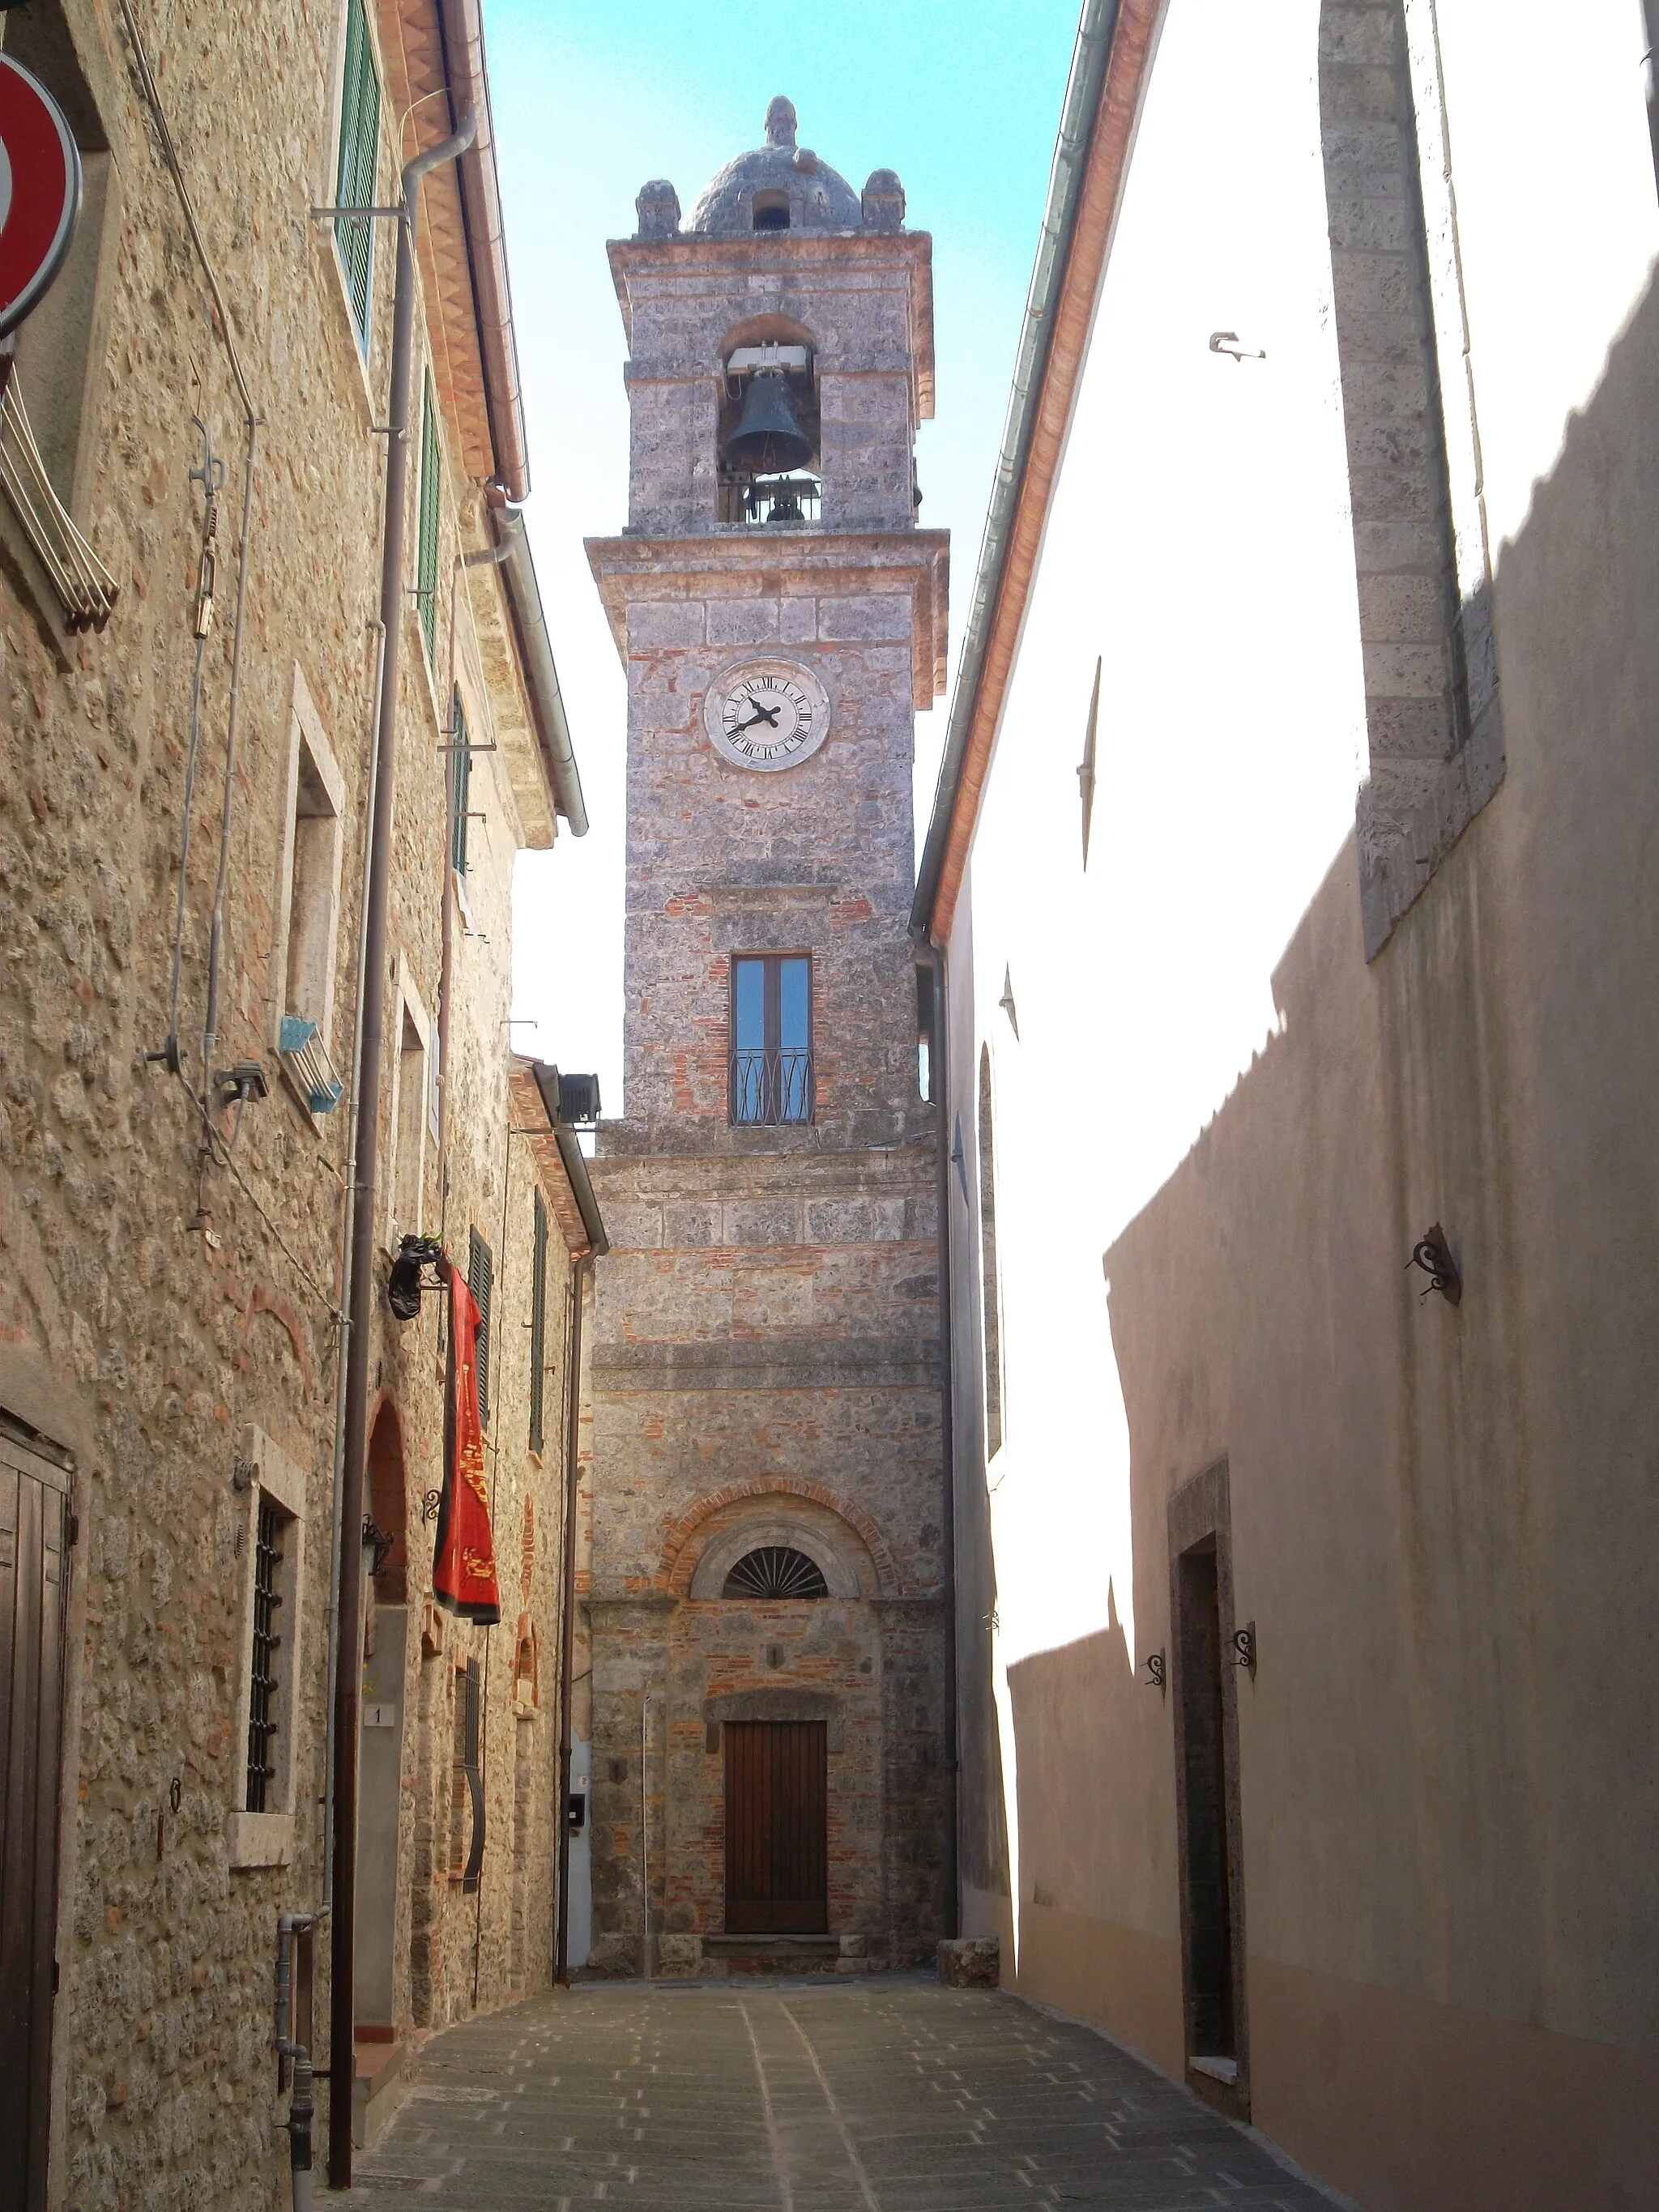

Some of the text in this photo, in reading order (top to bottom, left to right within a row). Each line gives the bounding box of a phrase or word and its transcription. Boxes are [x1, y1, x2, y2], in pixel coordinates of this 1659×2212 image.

[743, 681, 754, 693] XI
[761, 676, 773, 689] XII
[783, 682, 790, 693] I
[794, 695, 807, 704] II
[723, 714, 736, 722] IX
[799, 713, 812, 721] III
[742, 744, 753, 757] VII
[764, 747, 773, 759] VI
[783, 744, 791, 753] V
[375, 1709, 380, 1722] 1
[582, 1777, 587, 1785] 2
